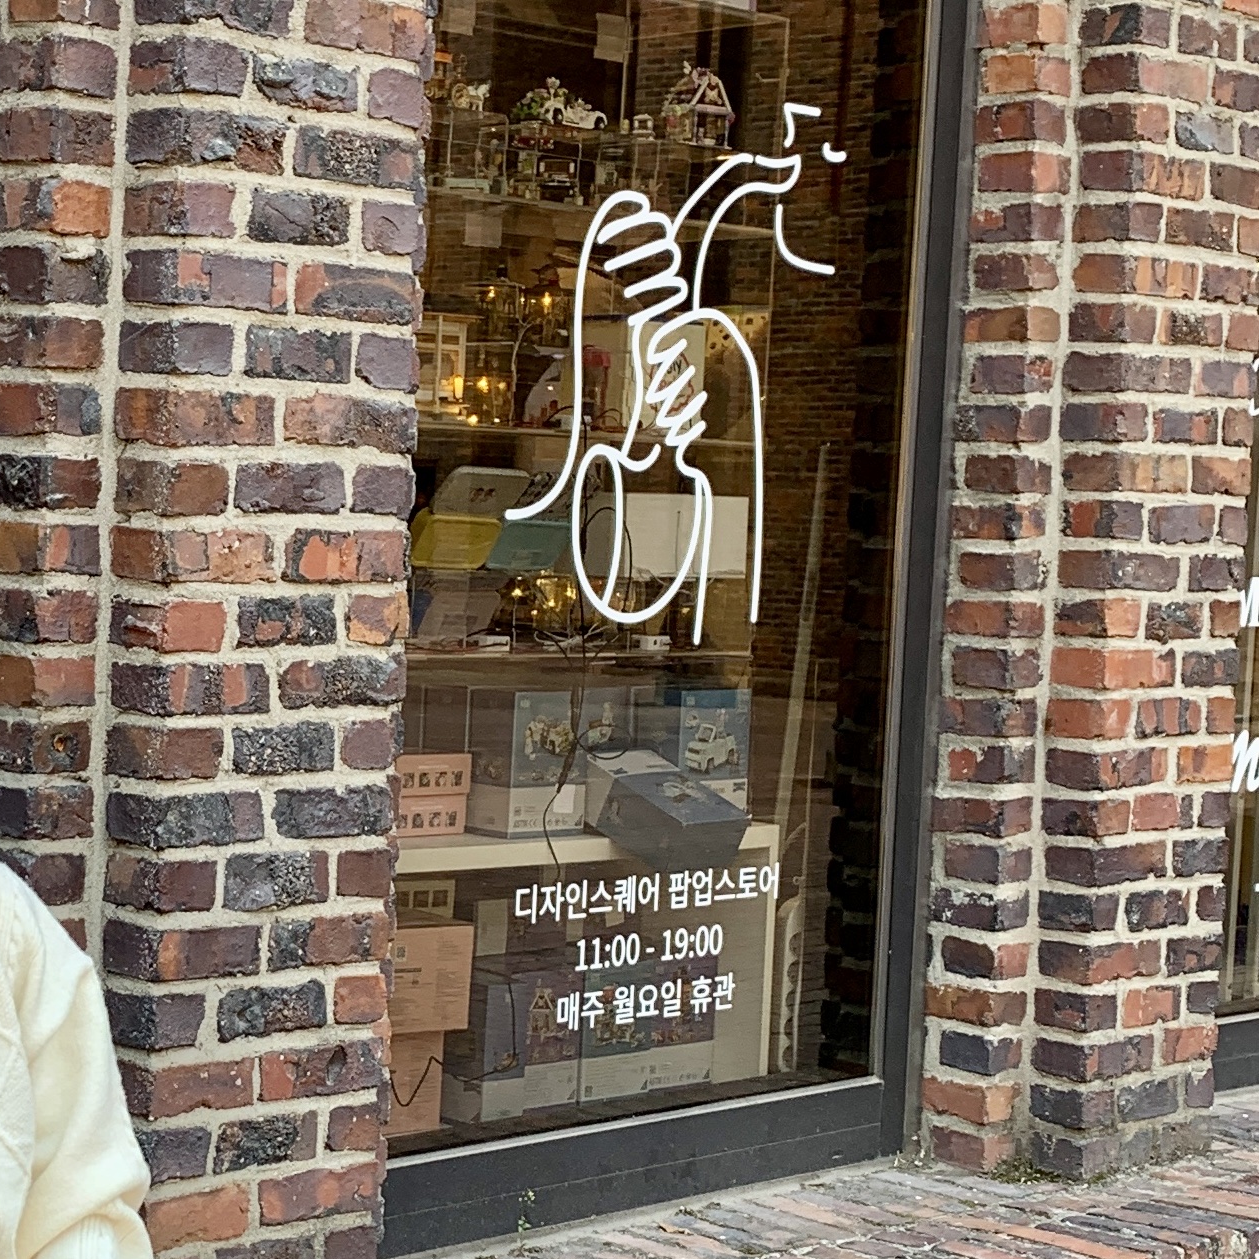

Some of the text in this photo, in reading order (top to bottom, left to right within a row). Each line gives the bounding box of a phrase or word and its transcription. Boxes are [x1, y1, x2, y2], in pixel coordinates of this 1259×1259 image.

[516, 862, 779, 923] 디자인스퀘어 팝업스토어
[575, 933, 640, 971] 11:00
[661, 924, 722, 961] 19:00
[557, 972, 735, 1030] 매주 월요일 휴관
